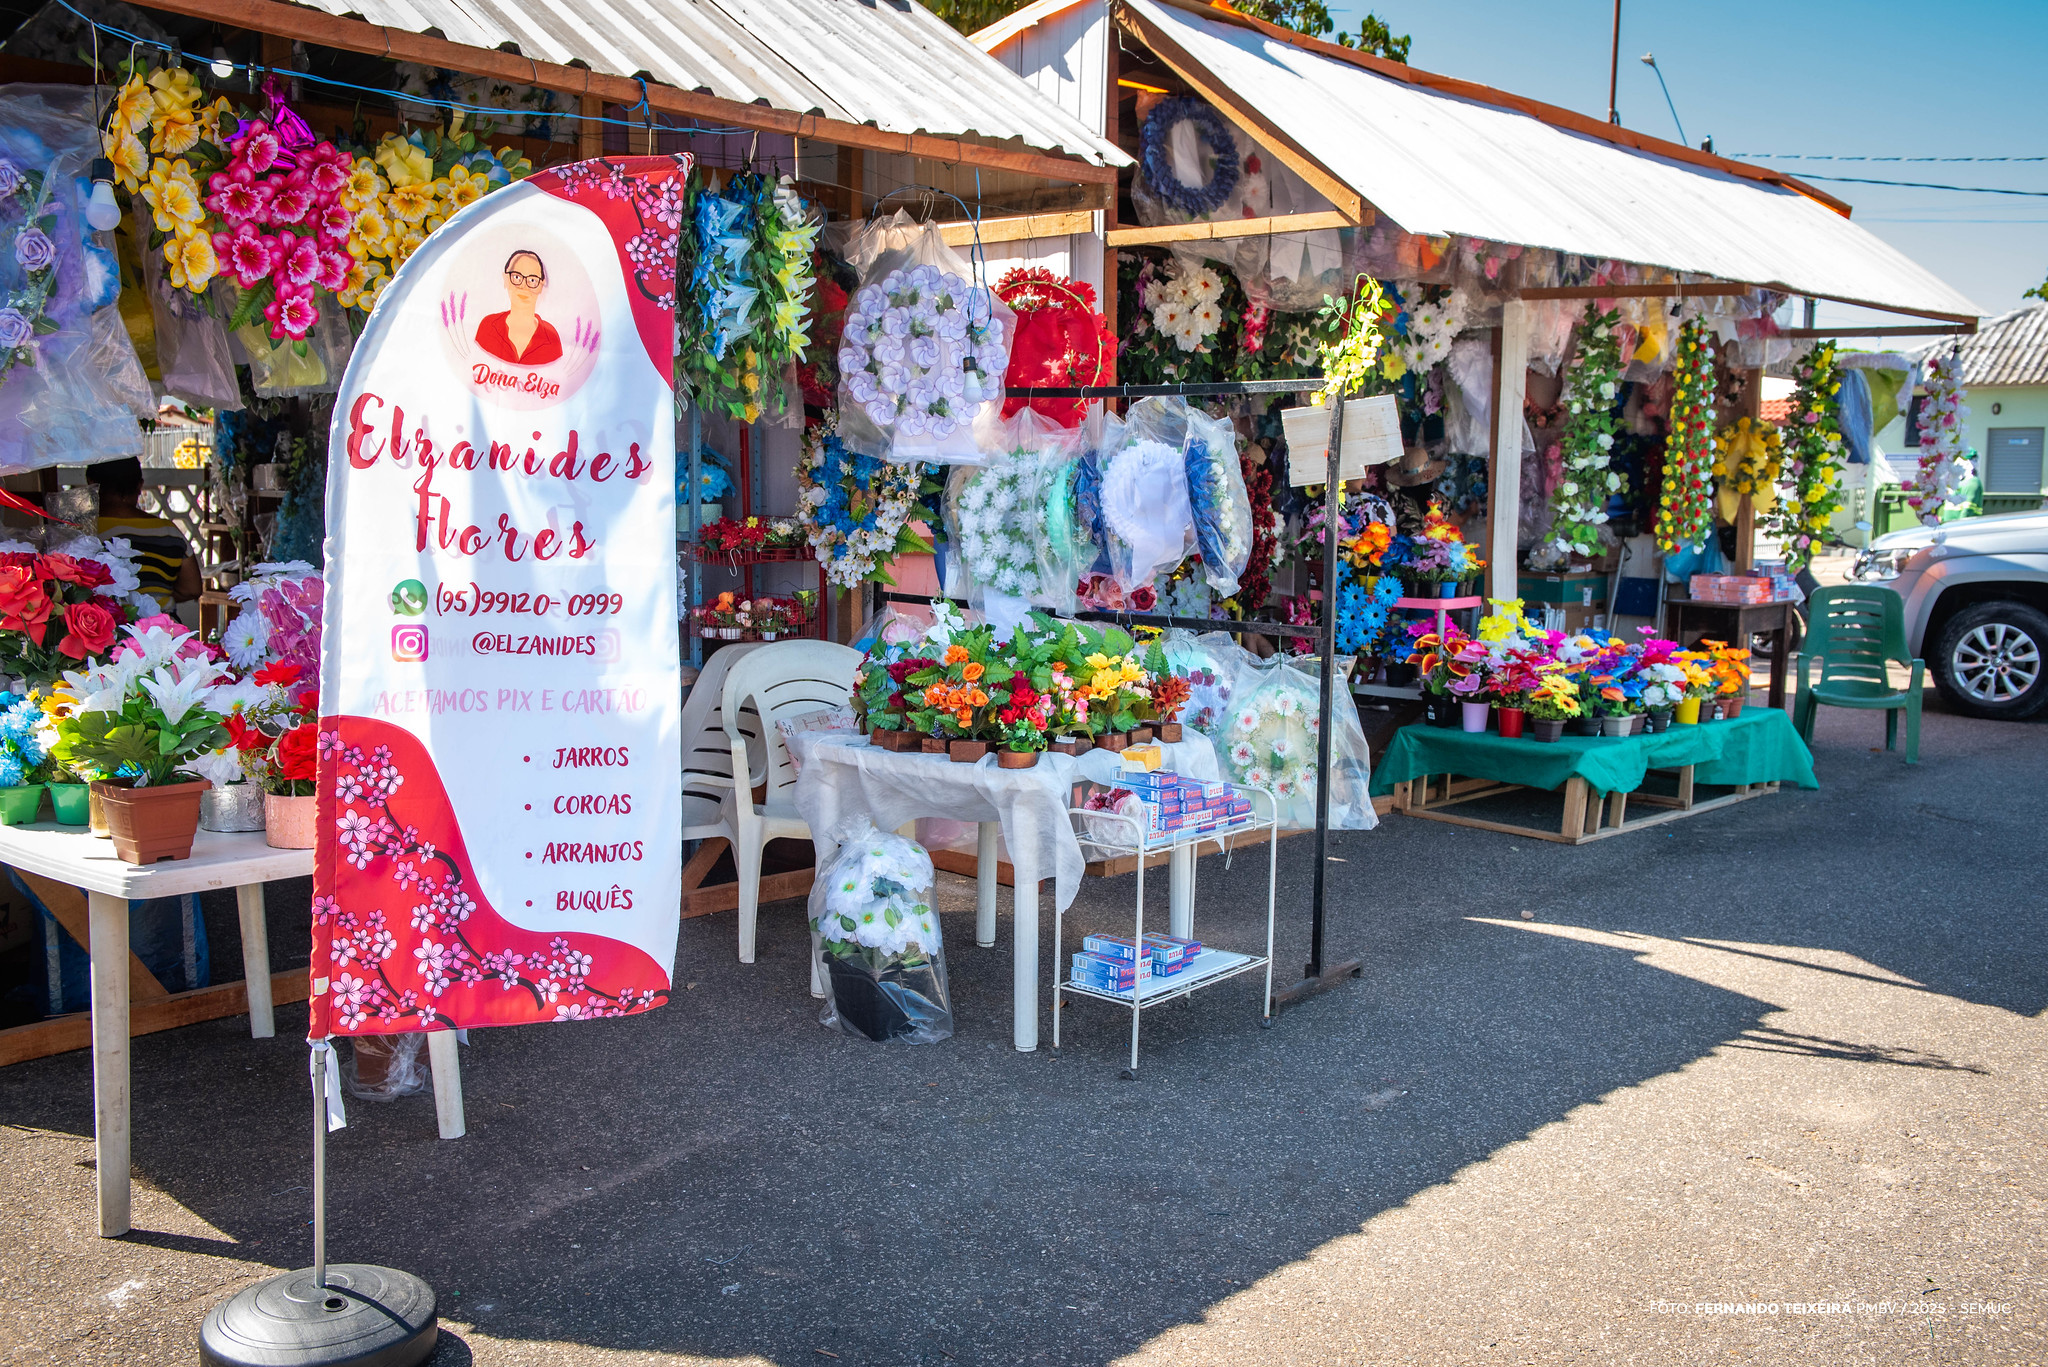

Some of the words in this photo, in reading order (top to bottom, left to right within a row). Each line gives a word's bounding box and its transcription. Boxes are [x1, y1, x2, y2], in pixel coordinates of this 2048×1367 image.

[472, 363, 519, 388] Dona
[523, 372, 561, 400] Elza
[346, 392, 652, 490] Elzanides
[471, 631, 597, 656] @ELZANIDES
[374, 687, 489, 716] ACEITAMOS
[497, 688, 535, 712] PIX
[541, 689, 556, 711] E
[561, 683, 648, 716] CARTÃO
[552, 746, 630, 769] JARROS
[553, 794, 632, 816] COROAS
[541, 840, 644, 865] ARRANJOS
[556, 884, 633, 914] BUQUÊS
